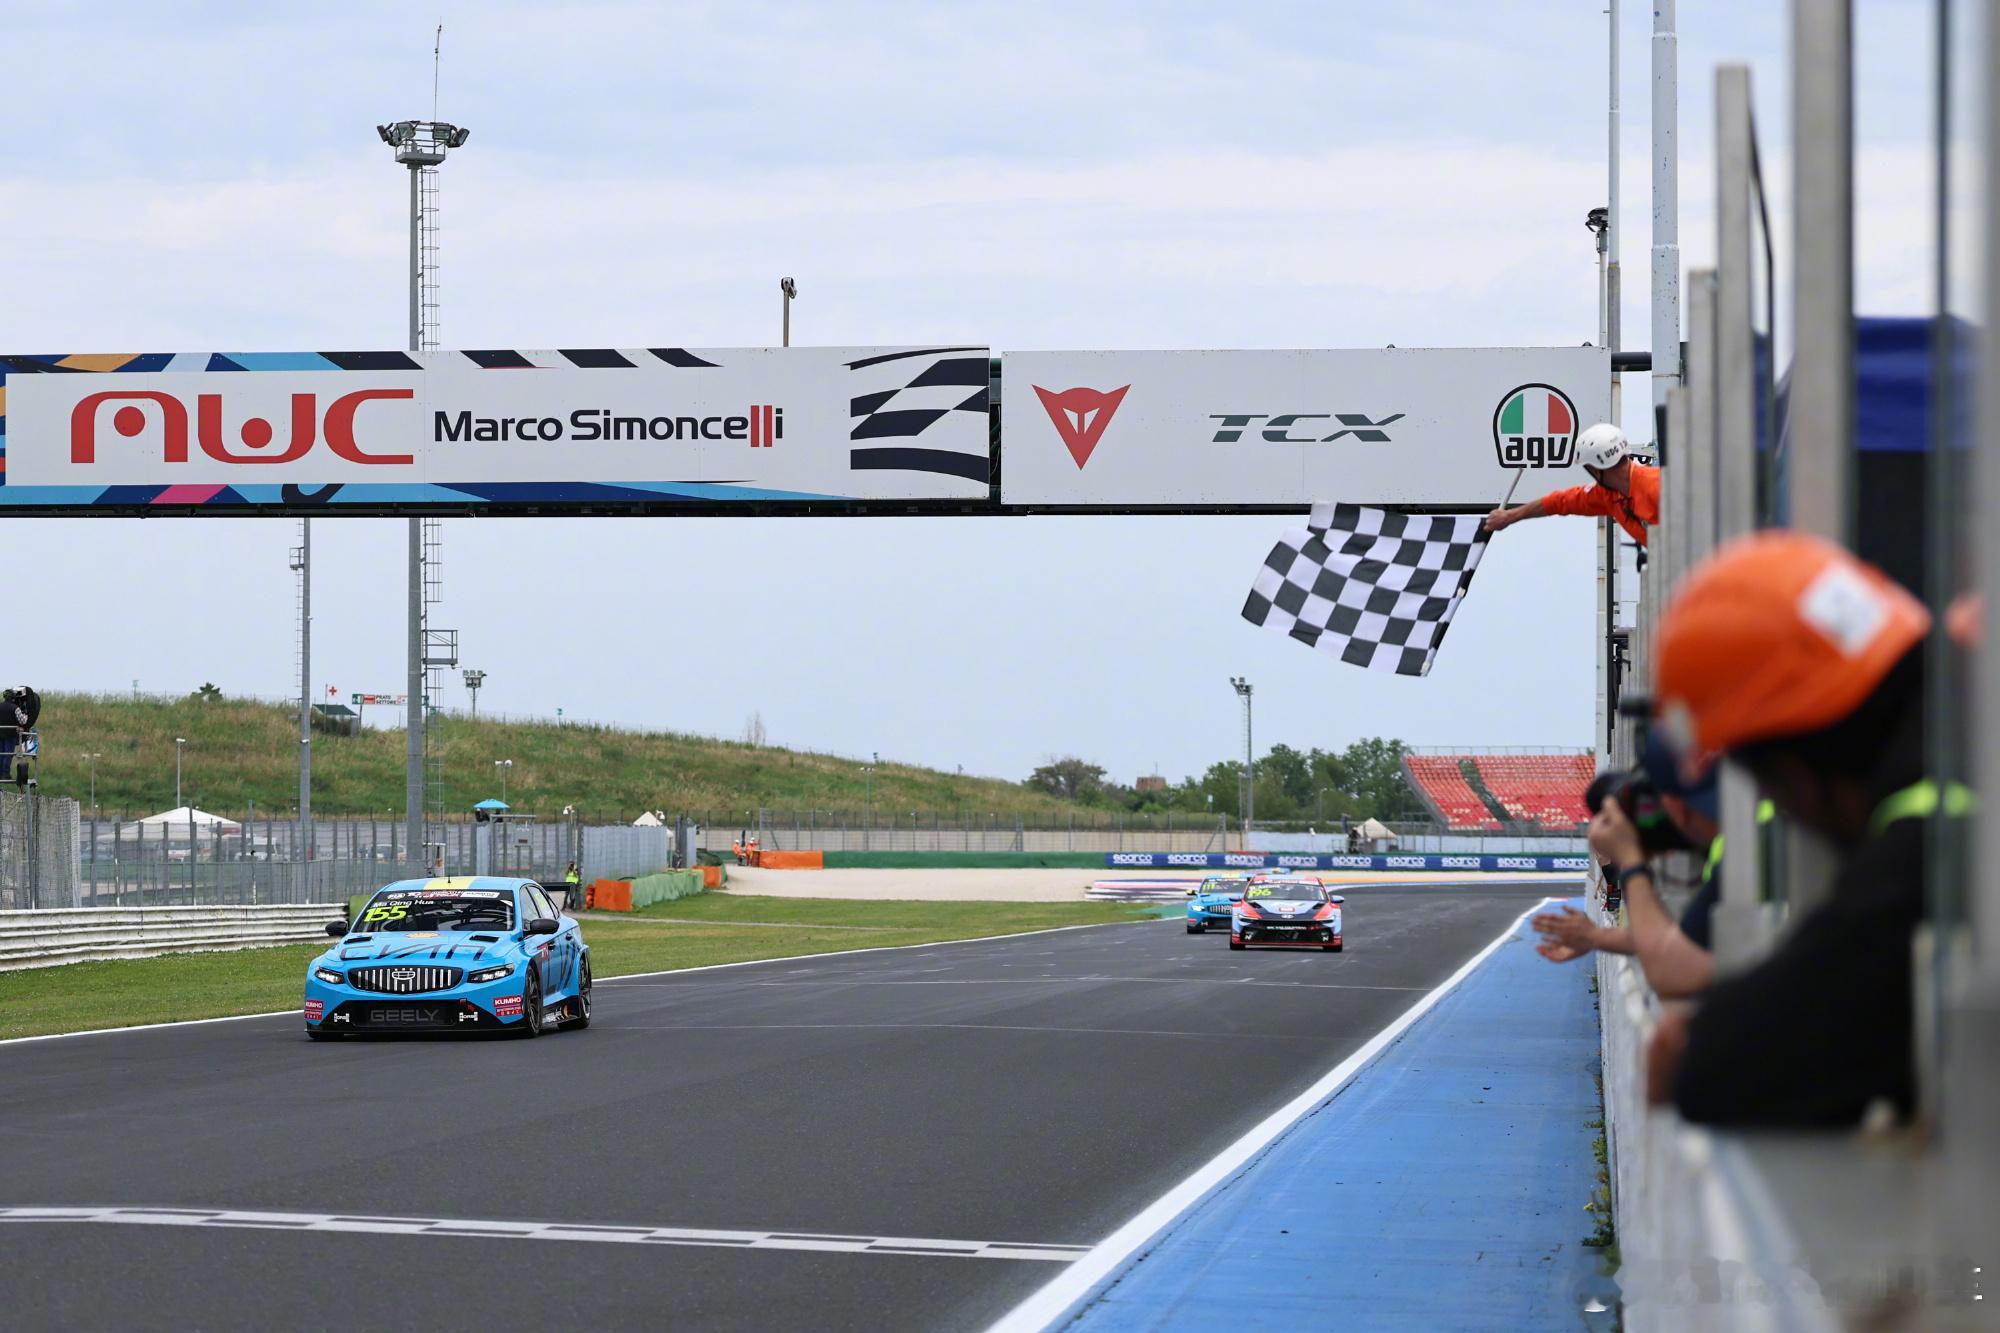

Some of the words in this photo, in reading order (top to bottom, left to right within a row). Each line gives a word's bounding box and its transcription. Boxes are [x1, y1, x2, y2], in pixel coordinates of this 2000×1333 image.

[434, 409, 563, 442] Marco
[571, 404, 784, 447] Simoncelli
[1209, 413, 1407, 443] TCX
[1505, 435, 1568, 468] agv
[1113, 854, 1152, 865] sparco
[1168, 854, 1207, 865] sparco
[1225, 855, 1264, 865] sparco
[1278, 856, 1318, 866] sparco
[1332, 856, 1371, 867] sparco
[1386, 857, 1425, 867] sparco
[1441, 857, 1480, 867] sparco
[1497, 857, 1536, 868] sparco
[364, 905, 410, 922] 155
[494, 996, 522, 1006] KUMHO
[370, 1009, 440, 1021] GEELY
